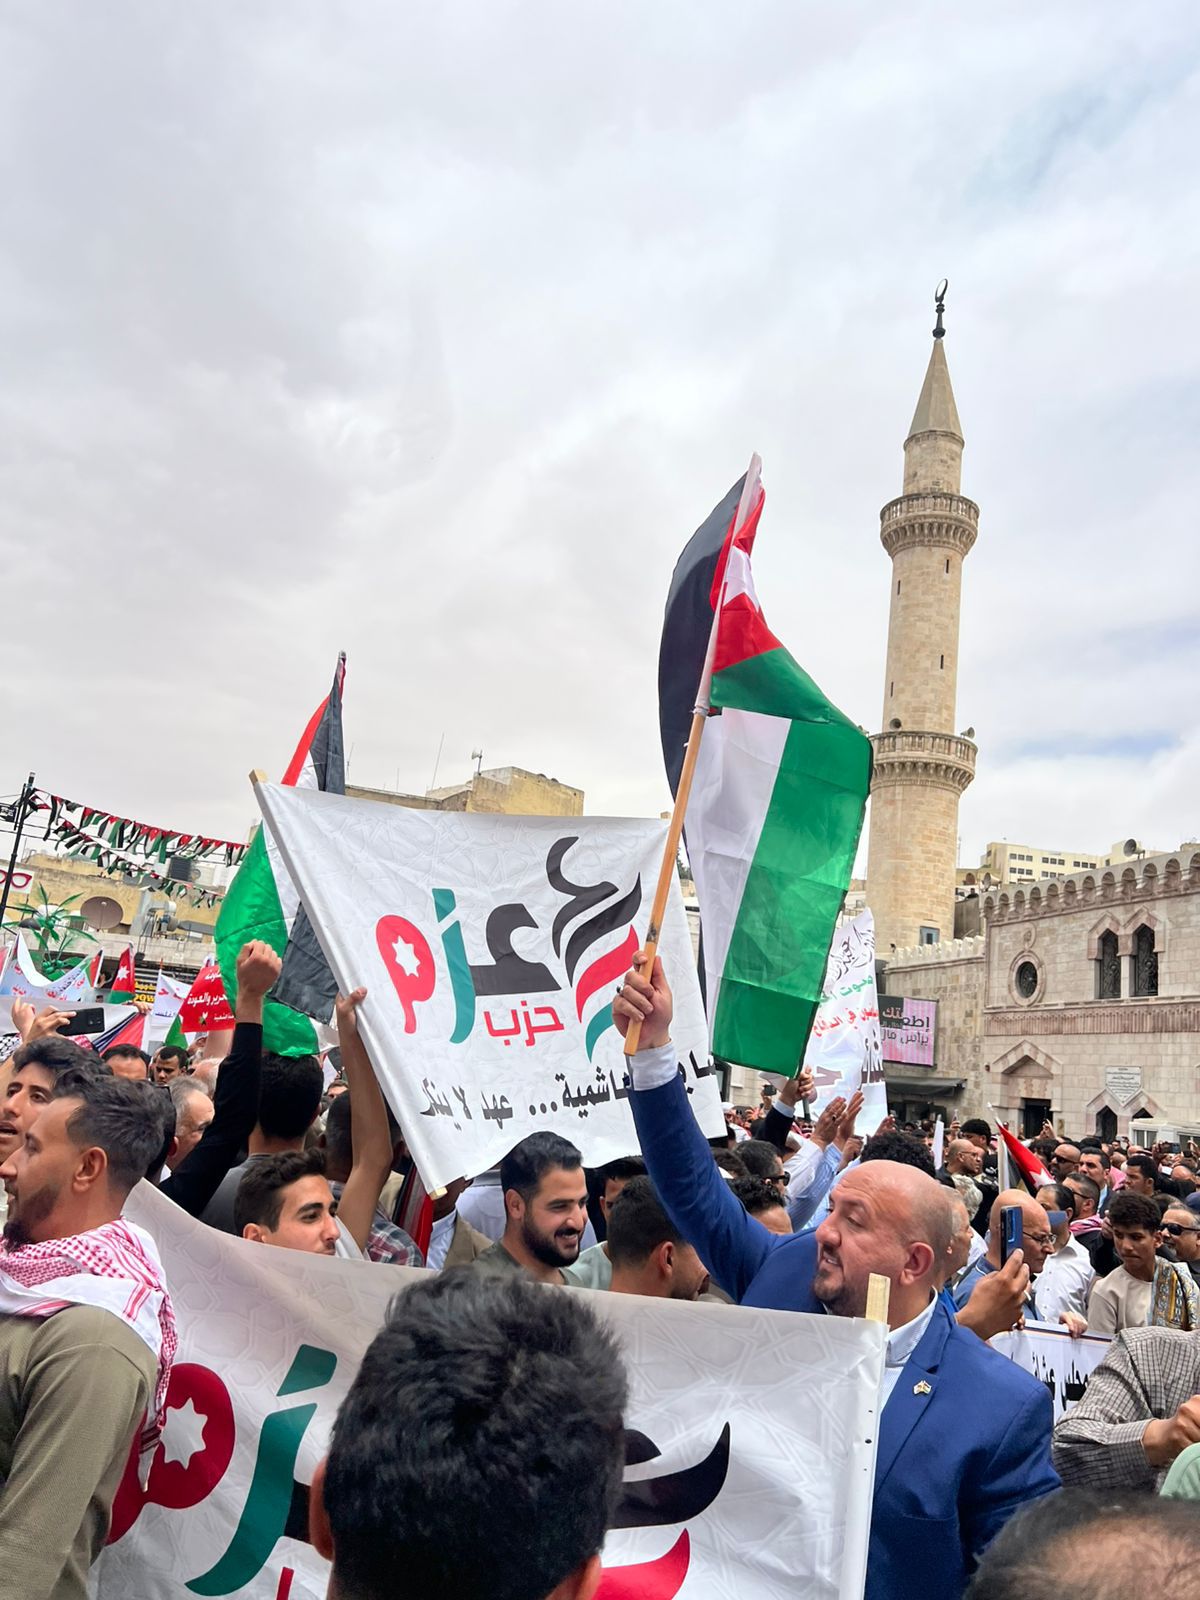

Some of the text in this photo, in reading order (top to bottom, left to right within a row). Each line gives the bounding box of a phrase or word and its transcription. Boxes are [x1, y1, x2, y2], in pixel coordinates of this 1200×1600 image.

[375, 887, 562, 1045] عزم
[483, 1000, 565, 1047] حزب
[481, 1091, 513, 1130] عهد
